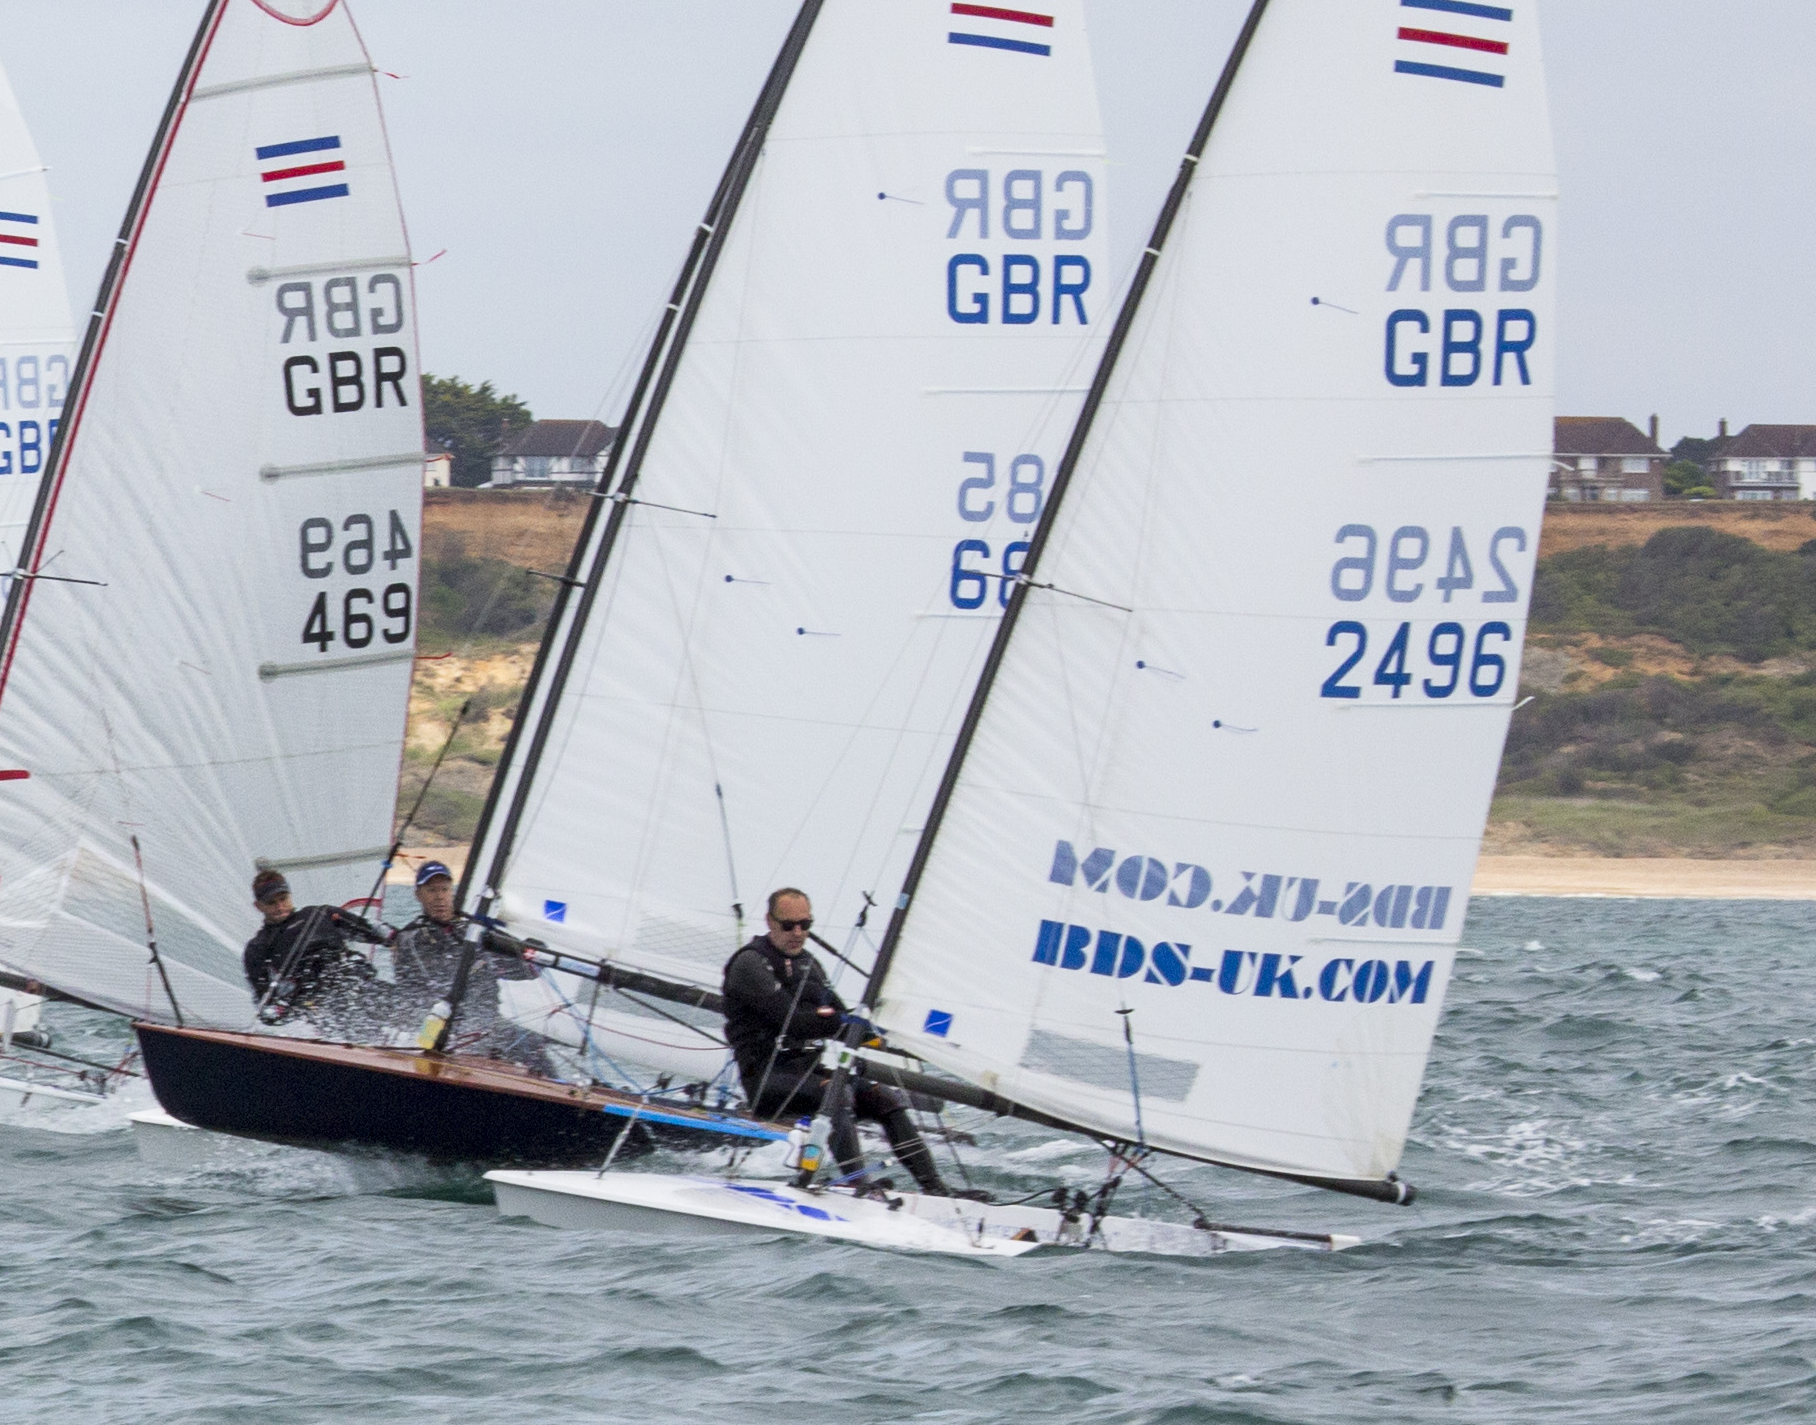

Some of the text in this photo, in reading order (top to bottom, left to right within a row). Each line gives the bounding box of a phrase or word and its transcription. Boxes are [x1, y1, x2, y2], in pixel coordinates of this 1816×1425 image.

[947, 253, 1092, 325] GBR
[283, 346, 408, 417] GBR
[1385, 309, 1537, 387] GBR
[950, 539, 1033, 609] 68
[301, 582, 412, 653] 469
[1320, 620, 1513, 700] 2496
[1031, 919, 1436, 1005] BDS-UK.COM
